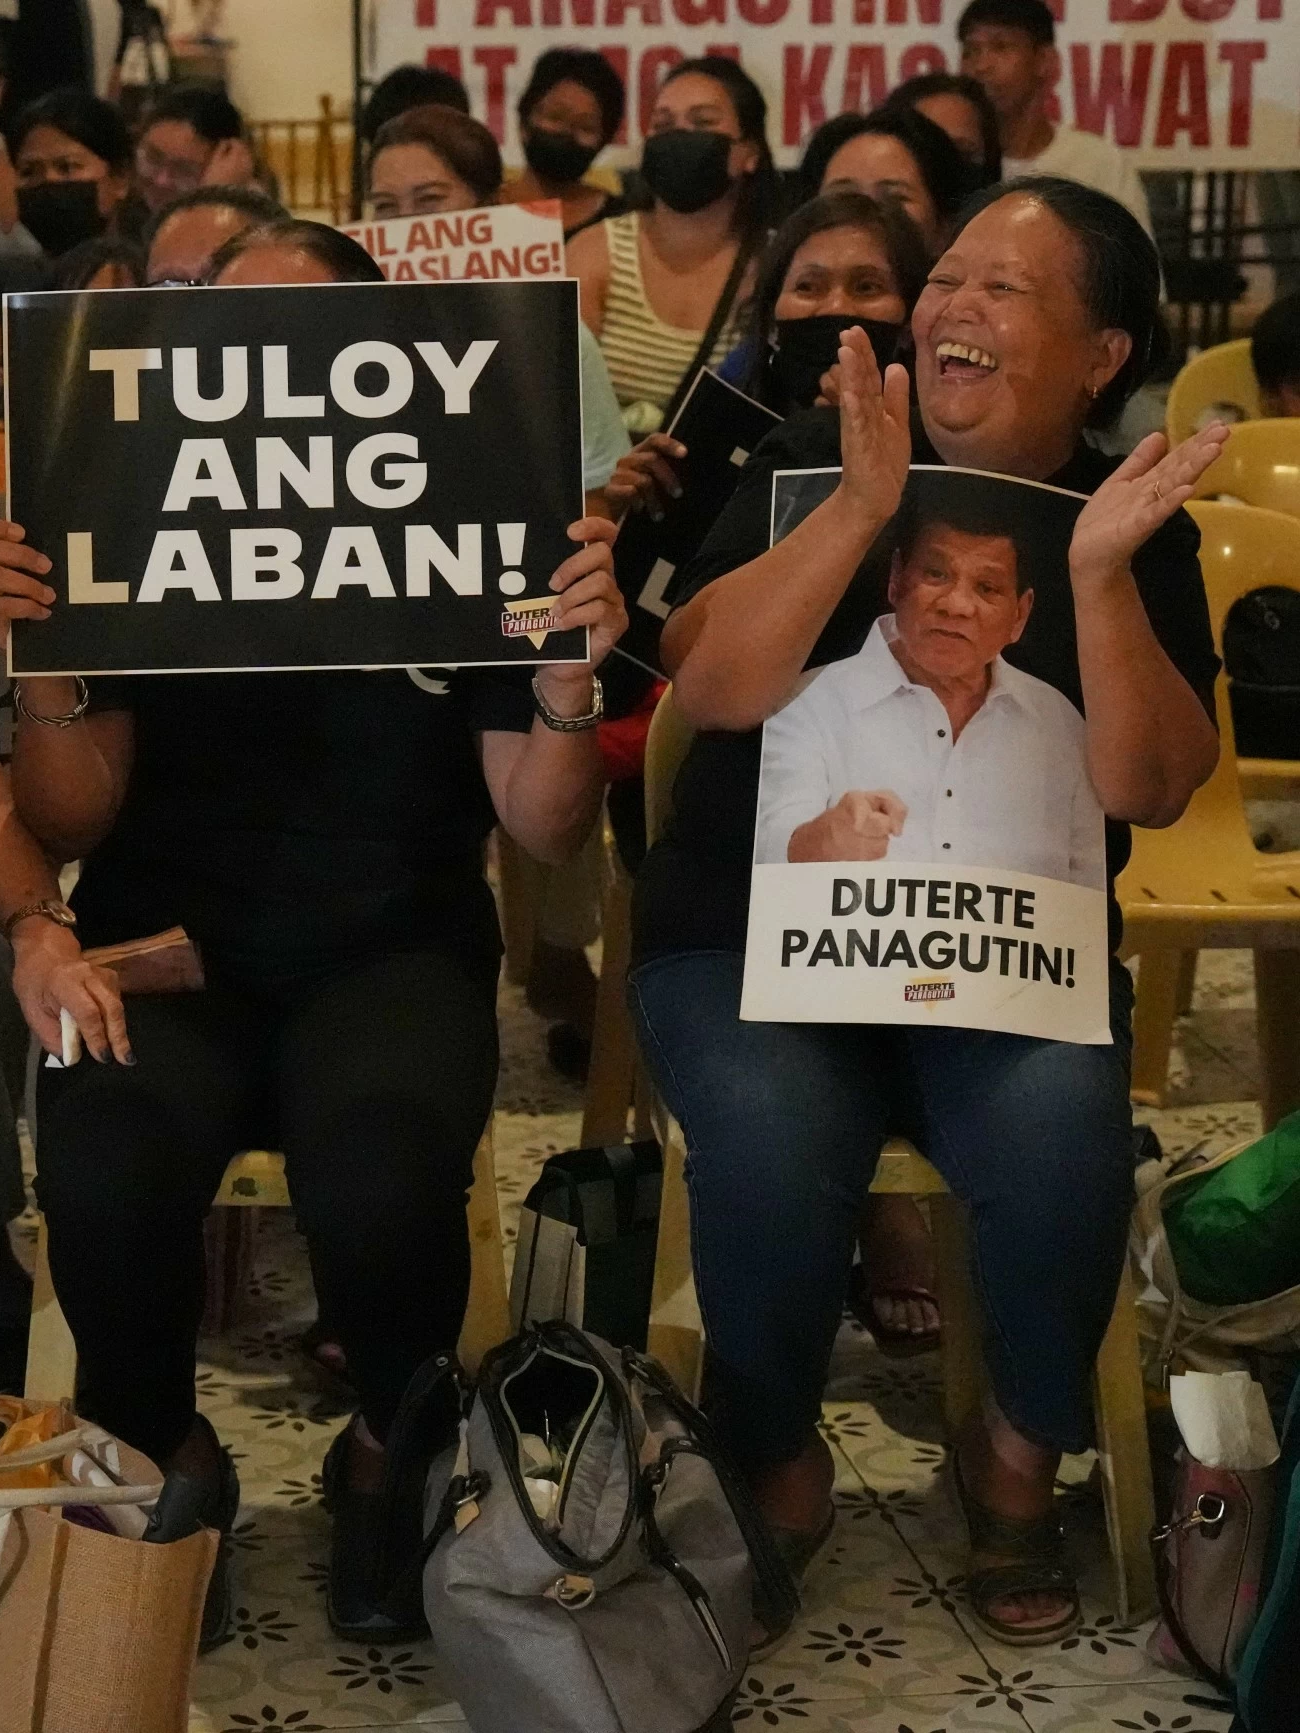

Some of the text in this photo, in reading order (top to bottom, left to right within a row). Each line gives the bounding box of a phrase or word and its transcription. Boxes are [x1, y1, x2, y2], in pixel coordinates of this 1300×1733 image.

[782, 41, 1267, 148] KAWAT
[345, 213, 493, 257] IL ANG
[379, 242, 560, 281] ASLANG!
[89, 340, 500, 422] TULOY
[161, 432, 428, 512] ANG
[66, 522, 527, 605] LABAN!
[503, 607, 550, 623] DUTER
[508, 615, 557, 633] PANAGUTI
[831, 878, 1036, 930] DUTERTE
[781, 928, 1076, 989] PANAGUTIN!
[904, 982, 955, 992] DUTERTE
